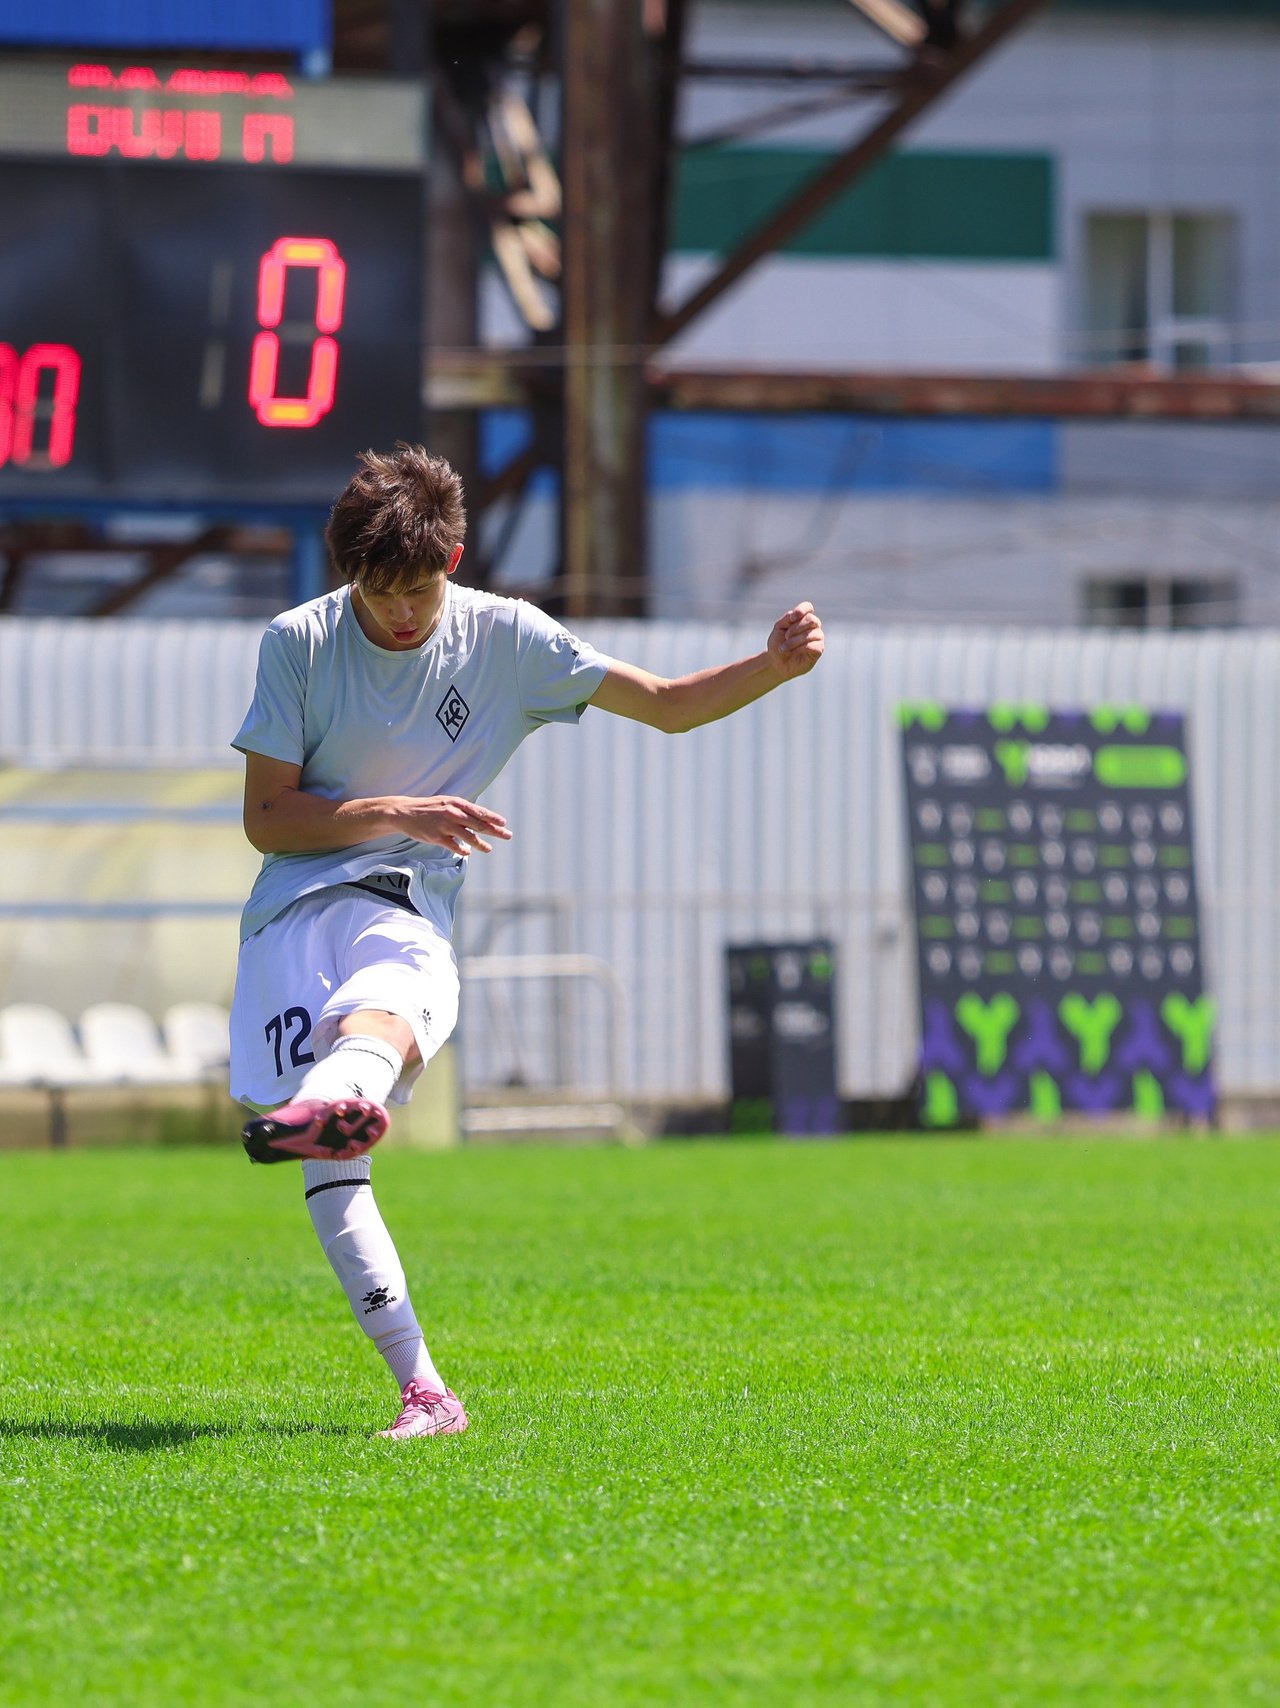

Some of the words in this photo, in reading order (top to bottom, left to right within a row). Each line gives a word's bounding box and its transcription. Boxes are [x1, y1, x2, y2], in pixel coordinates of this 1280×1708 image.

[248, 237, 347, 428] 0
[265, 1006, 316, 1078] 72
[364, 1295, 397, 1315] KELME
